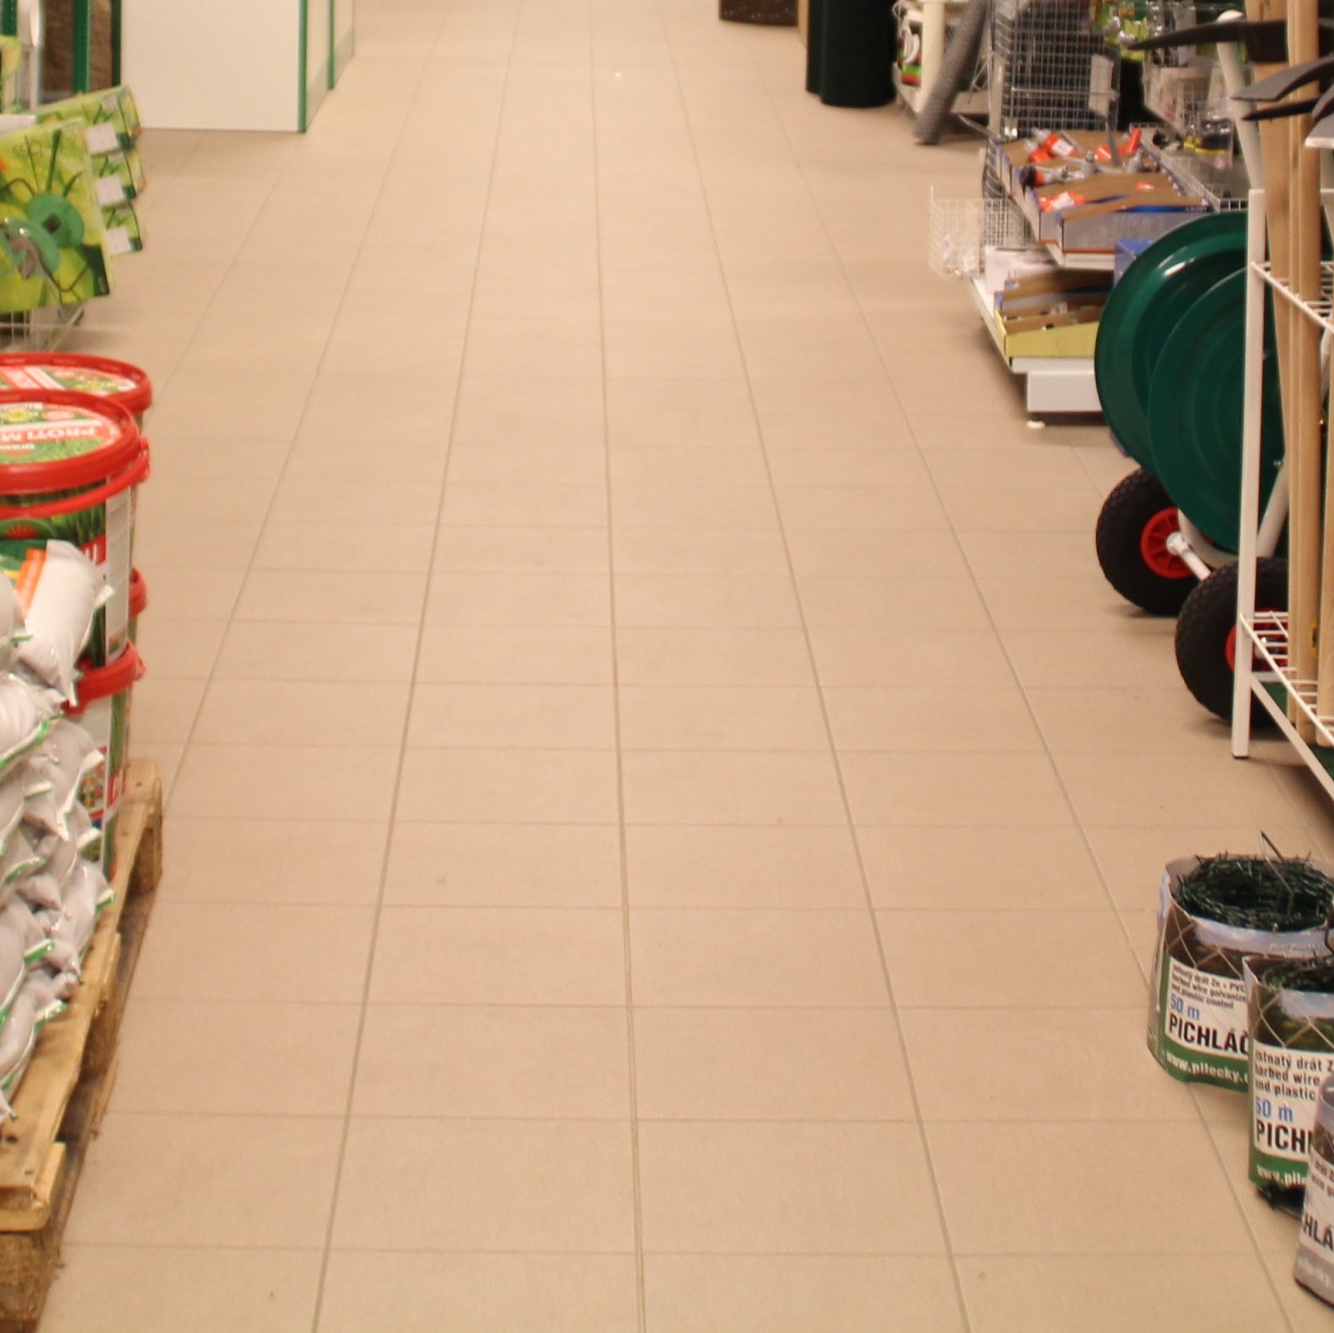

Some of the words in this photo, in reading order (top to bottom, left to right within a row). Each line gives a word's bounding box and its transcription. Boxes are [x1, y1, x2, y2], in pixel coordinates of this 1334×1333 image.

[1170, 993, 1185, 1014] 50
[1187, 1006, 1200, 1021] m
[1295, 1057, 1323, 1072] drát
[1293, 1071, 1320, 1087] wire
[1274, 1082, 1316, 1102] plastic
[1278, 1106, 1294, 1123] m
